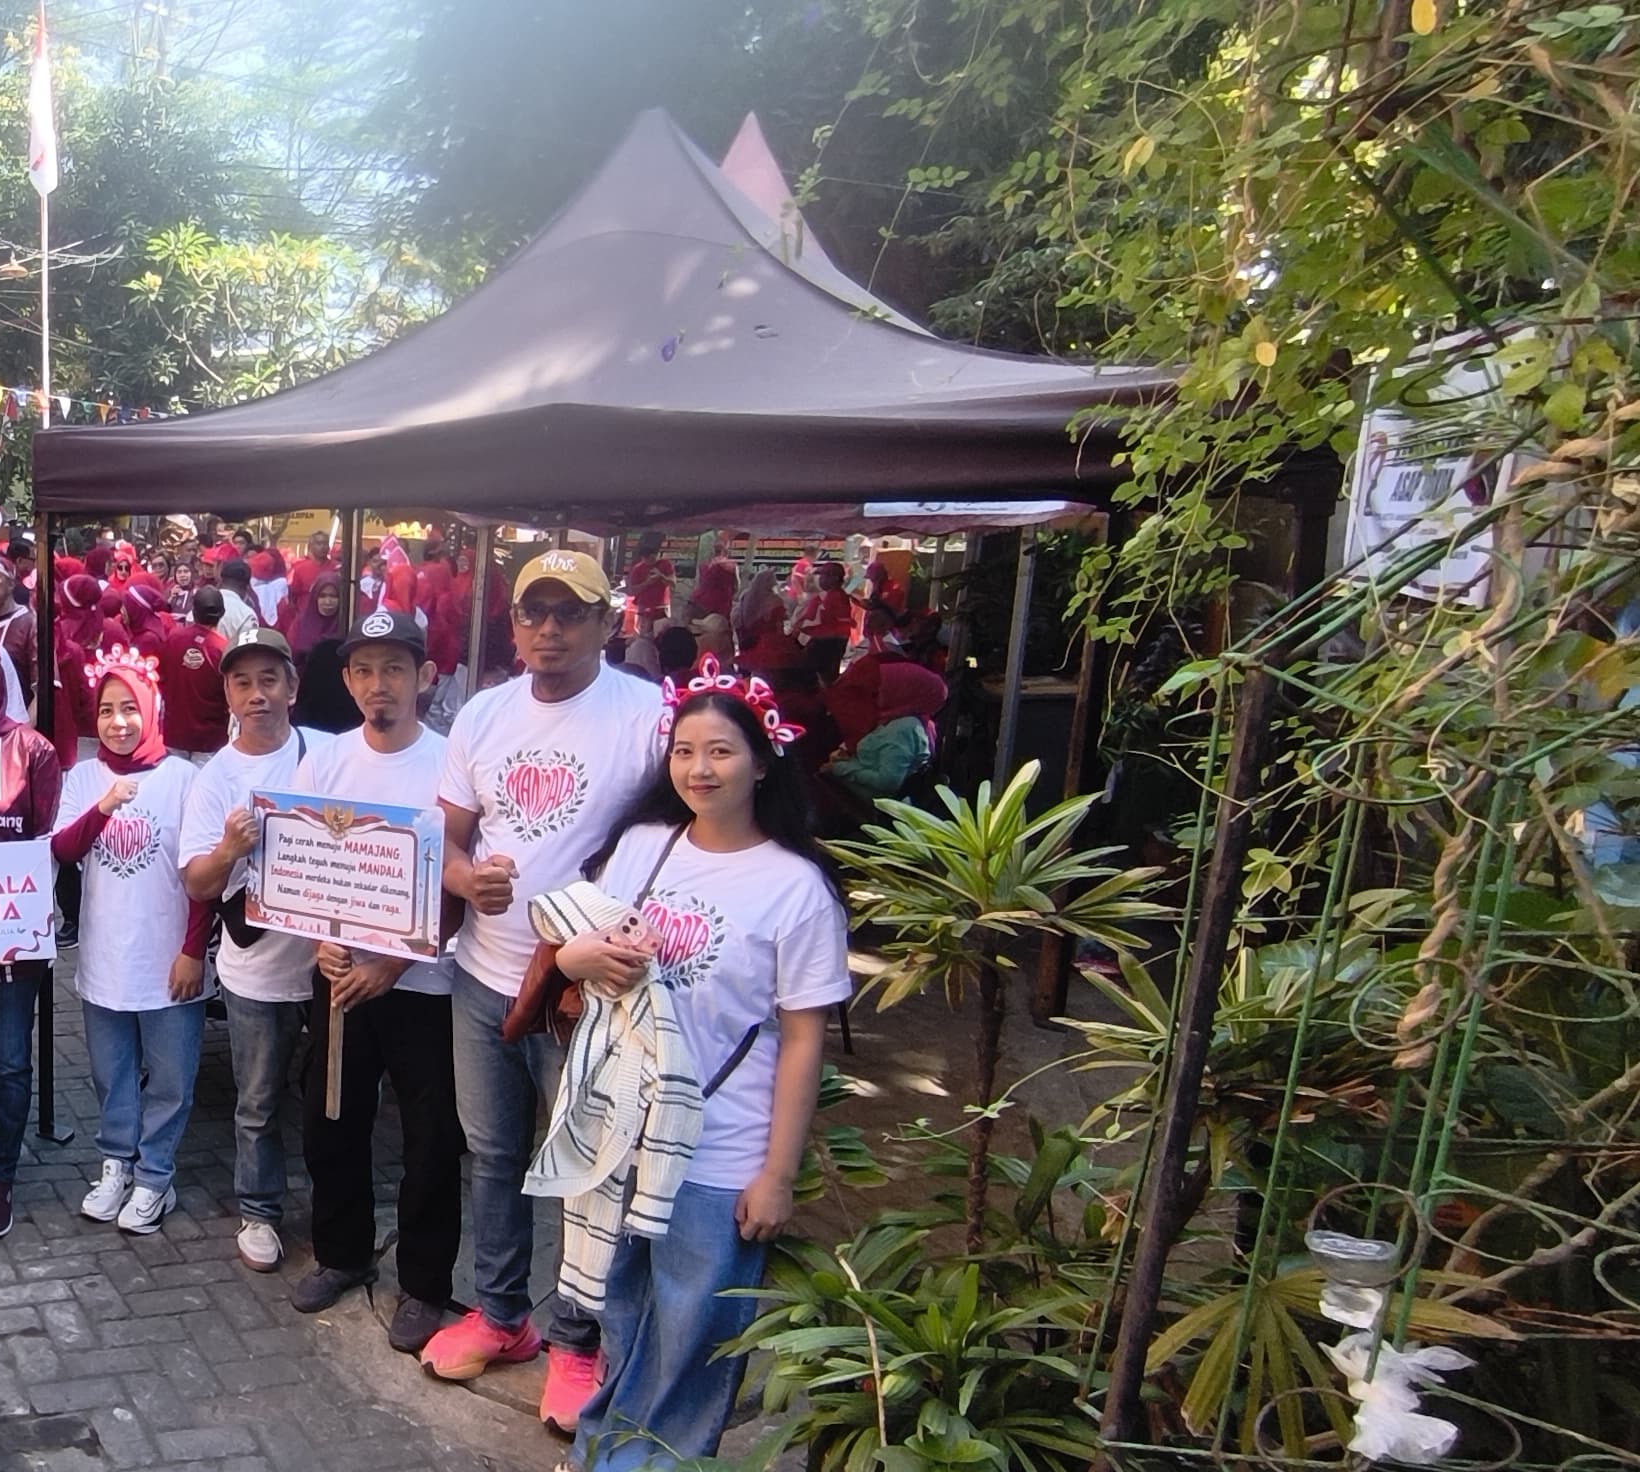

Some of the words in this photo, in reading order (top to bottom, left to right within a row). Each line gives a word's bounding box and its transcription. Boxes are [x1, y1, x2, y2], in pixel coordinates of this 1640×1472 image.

[506, 764, 575, 824] MANDALA
[278, 833, 293, 847] Pagi
[295, 836, 314, 847] cerah
[316, 841, 341, 853] menuju
[278, 851, 306, 865] Langkah
[308, 855, 328, 868] teguh
[330, 860, 356, 873] menuju
[271, 864, 303, 880] Indonesia
[305, 873, 331, 884] merdeka
[333, 877, 351, 888] bukan
[277, 883, 301, 896] Namun
[302, 887, 324, 902] dijaga
[326, 893, 348, 905] dengan
[350, 896, 366, 909] jiwa
[368, 900, 381, 911] dan
